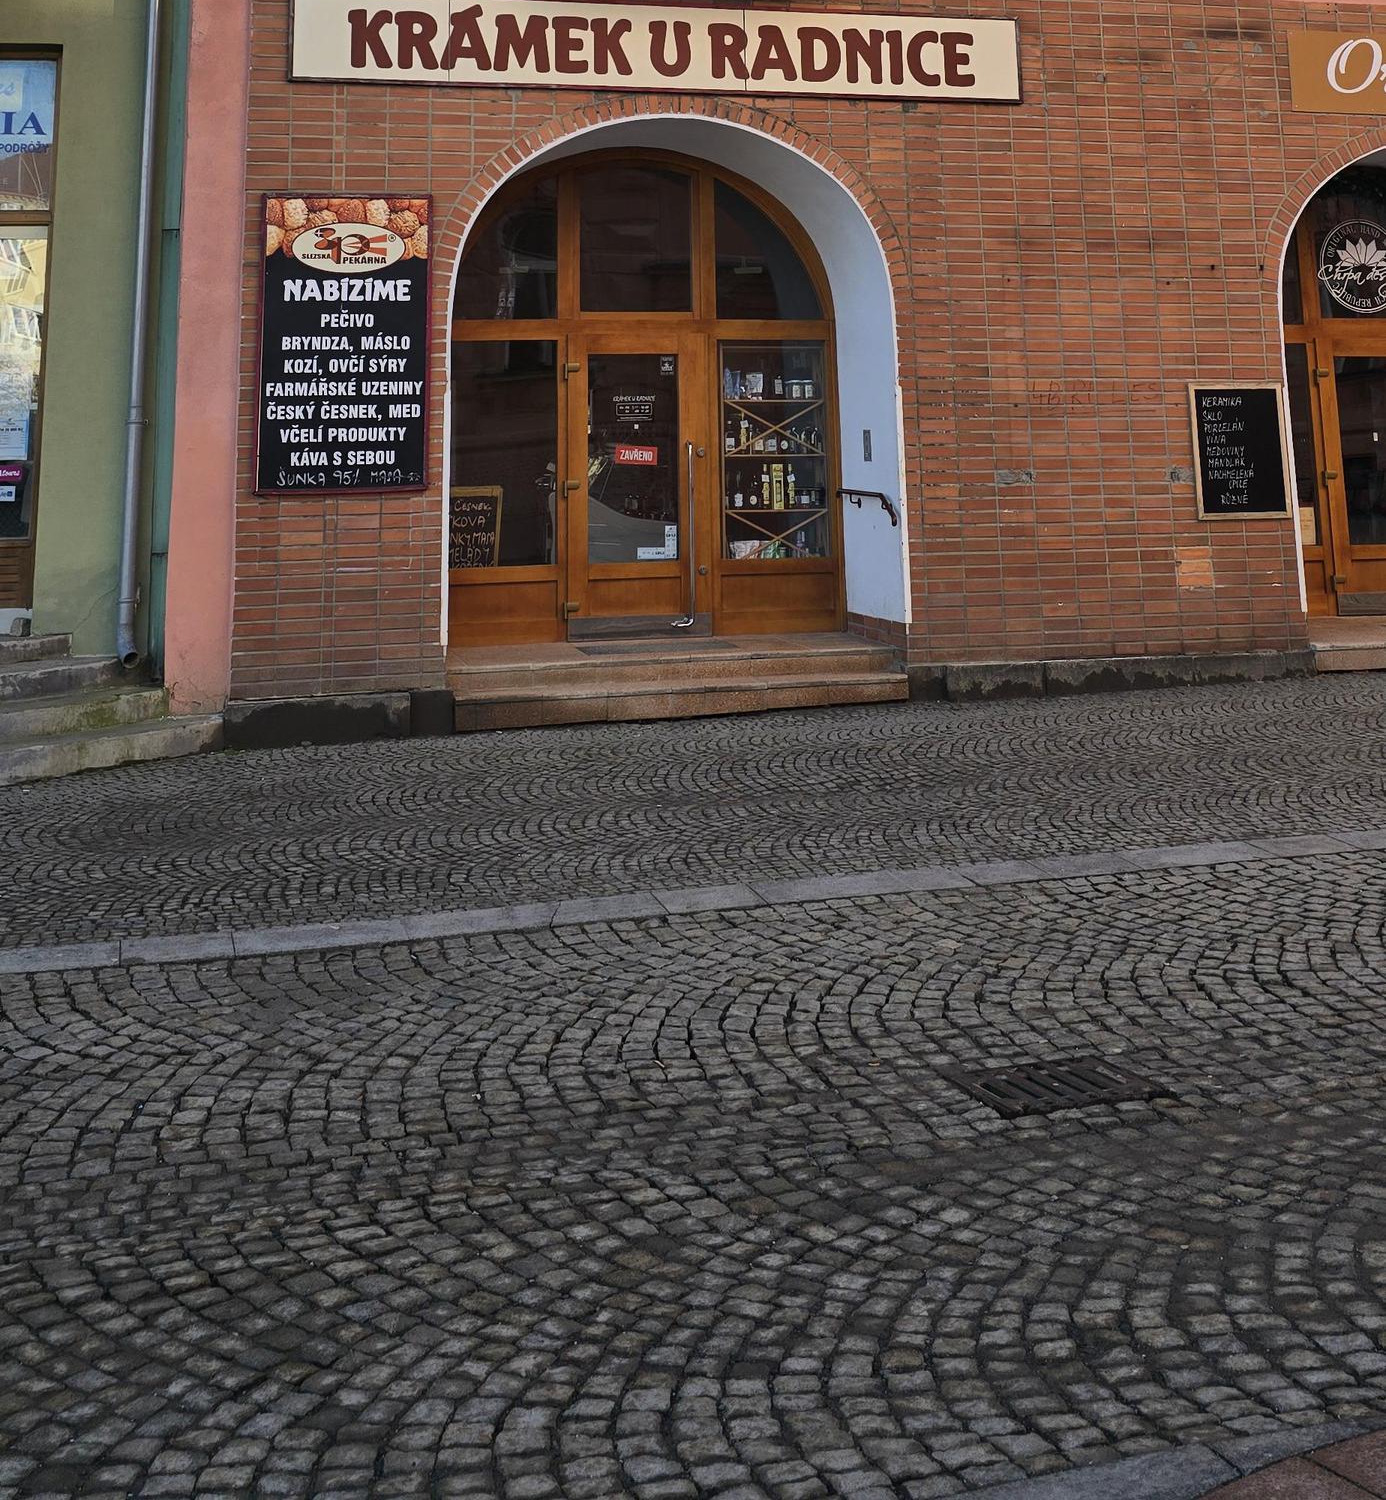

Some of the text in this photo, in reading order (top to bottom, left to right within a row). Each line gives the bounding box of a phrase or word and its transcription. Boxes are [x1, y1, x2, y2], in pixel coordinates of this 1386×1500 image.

[348, 5, 976, 87] KRÁMEK U RADNICE
[343, 255, 387, 264] PEKÁRNA
[283, 277, 411, 301] NABÍZÍME
[320, 310, 374, 328] PEČIVO
[282, 333, 410, 352] BRYNDZA, MÁSLO
[284, 354, 407, 375] KOZÍ, OVČÍ SÝRY
[266, 378, 423, 397] FARMÁŘSKÉ UZENINY
[267, 400, 421, 421] ČESKÝ ČESNEK, MED
[1202, 396, 1242, 407] KERAMIKA
[280, 424, 406, 443] VČELÍ PRODUKTY
[290, 449, 395, 466] KÁVA S SEBOU
[620, 448, 653, 461] ZAVŘENO
[276, 466, 326, 486] ŠUNKA
